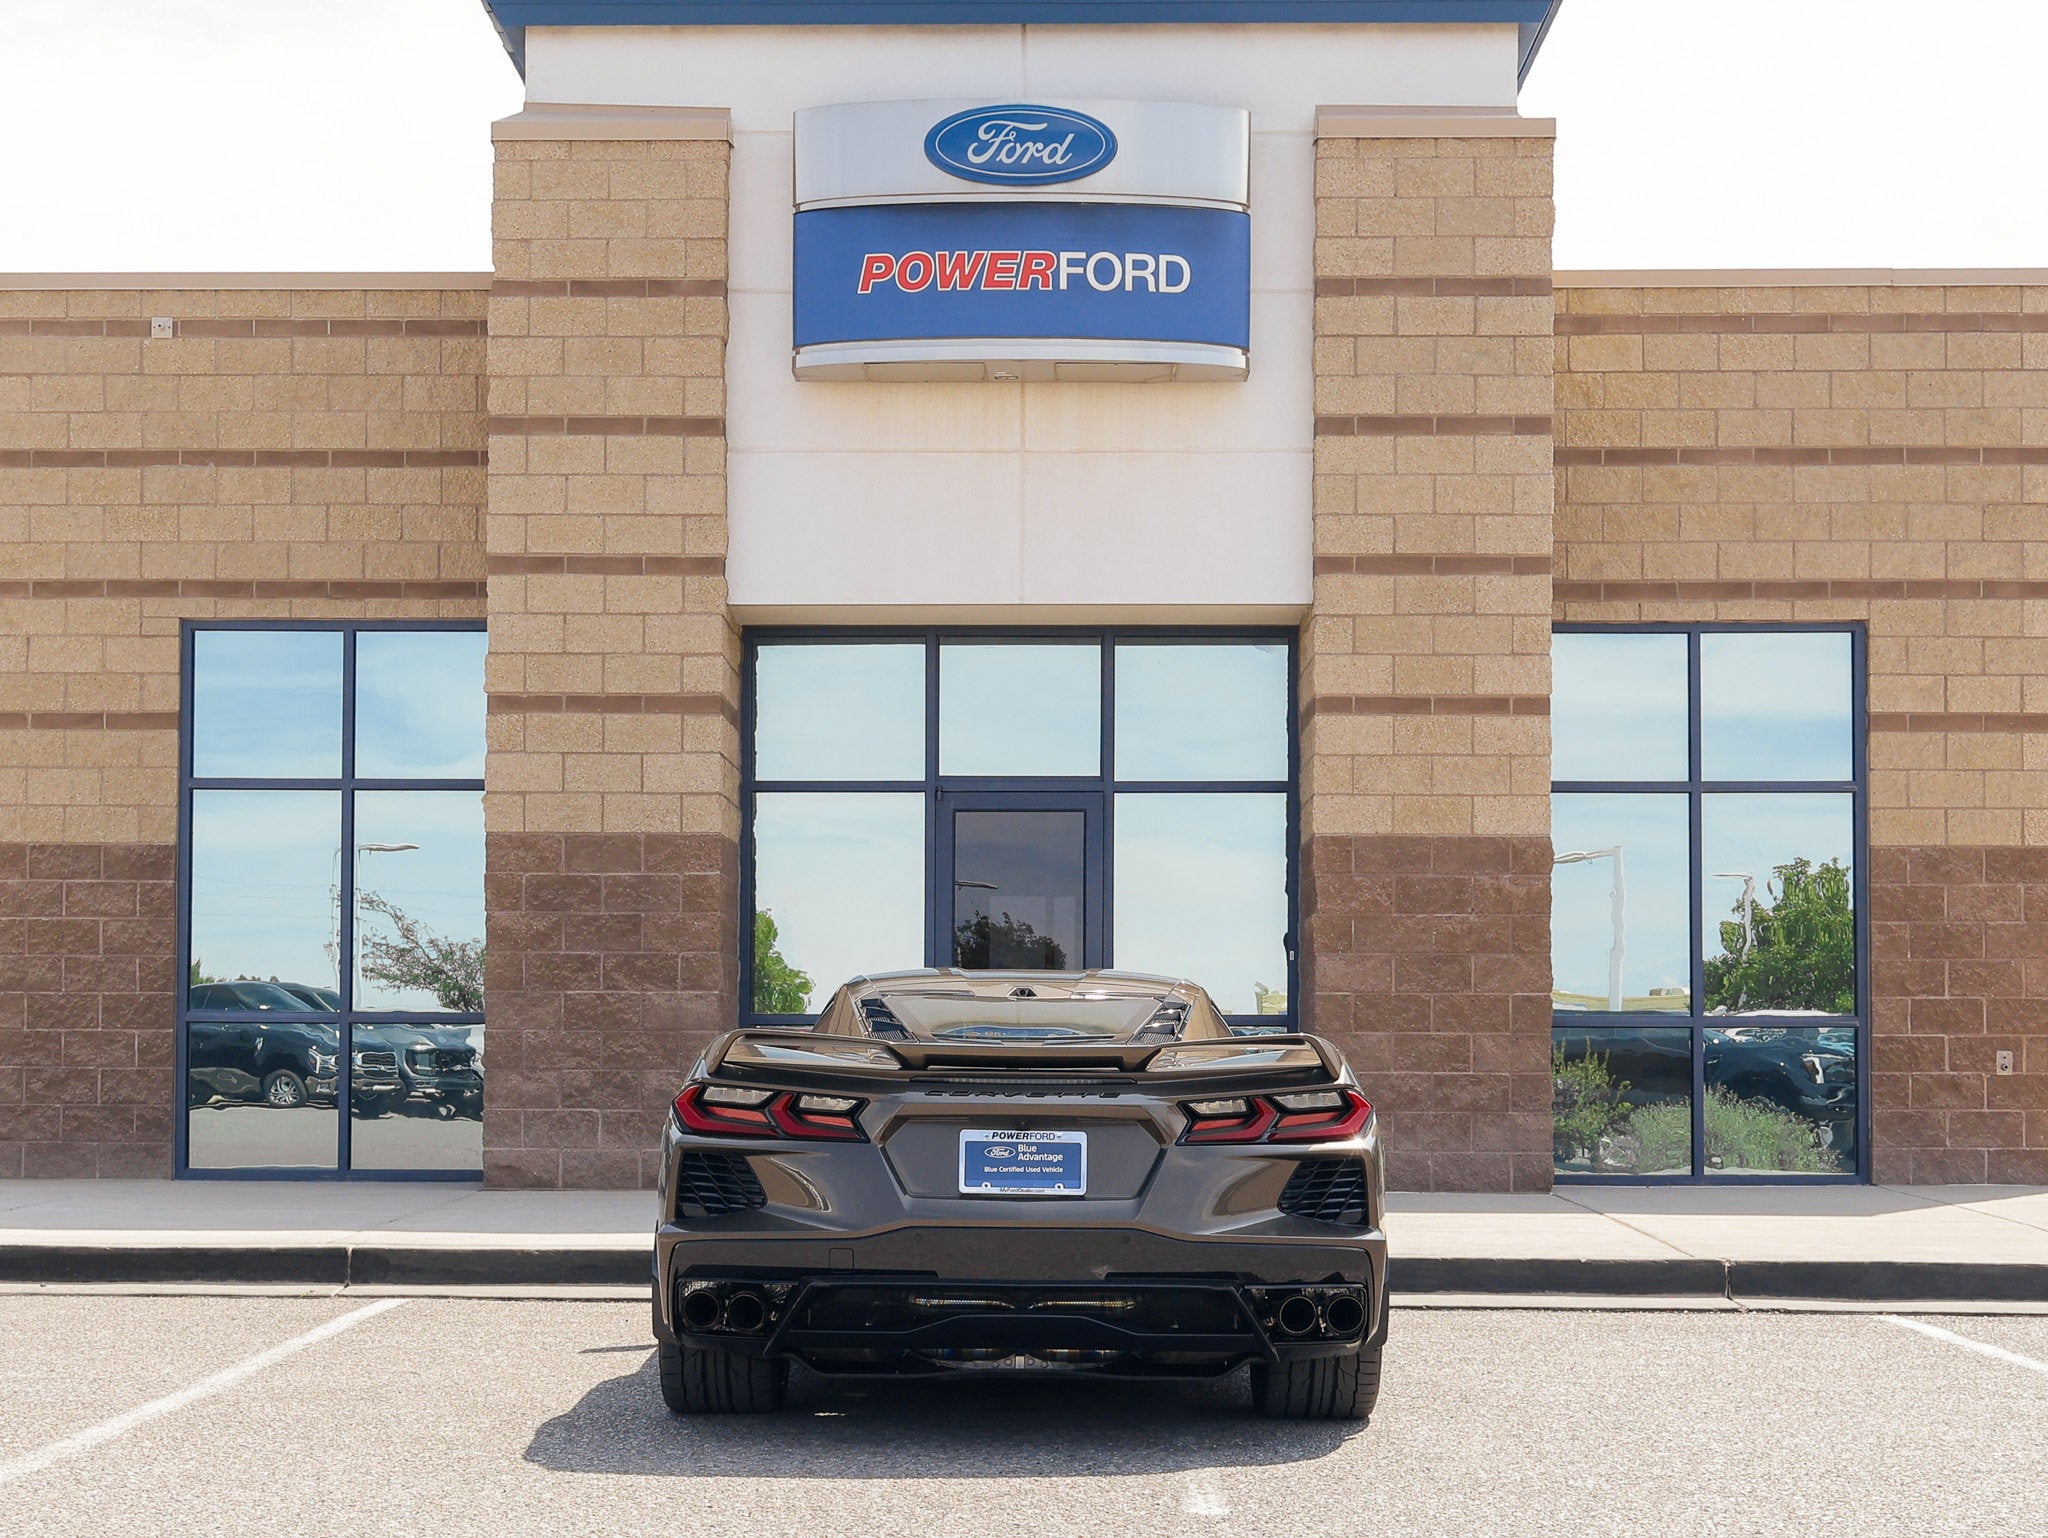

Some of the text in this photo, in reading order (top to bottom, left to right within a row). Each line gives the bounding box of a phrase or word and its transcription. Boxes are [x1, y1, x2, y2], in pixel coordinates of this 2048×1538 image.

[966, 119, 1075, 167] Ford
[857, 250, 1192, 295] POWERFORD
[991, 1131, 1056, 1141] POWERFORD
[989, 1148, 1011, 1157] Ford
[1017, 1144, 1037, 1152] Blue
[1017, 1153, 1064, 1163] Advantage
